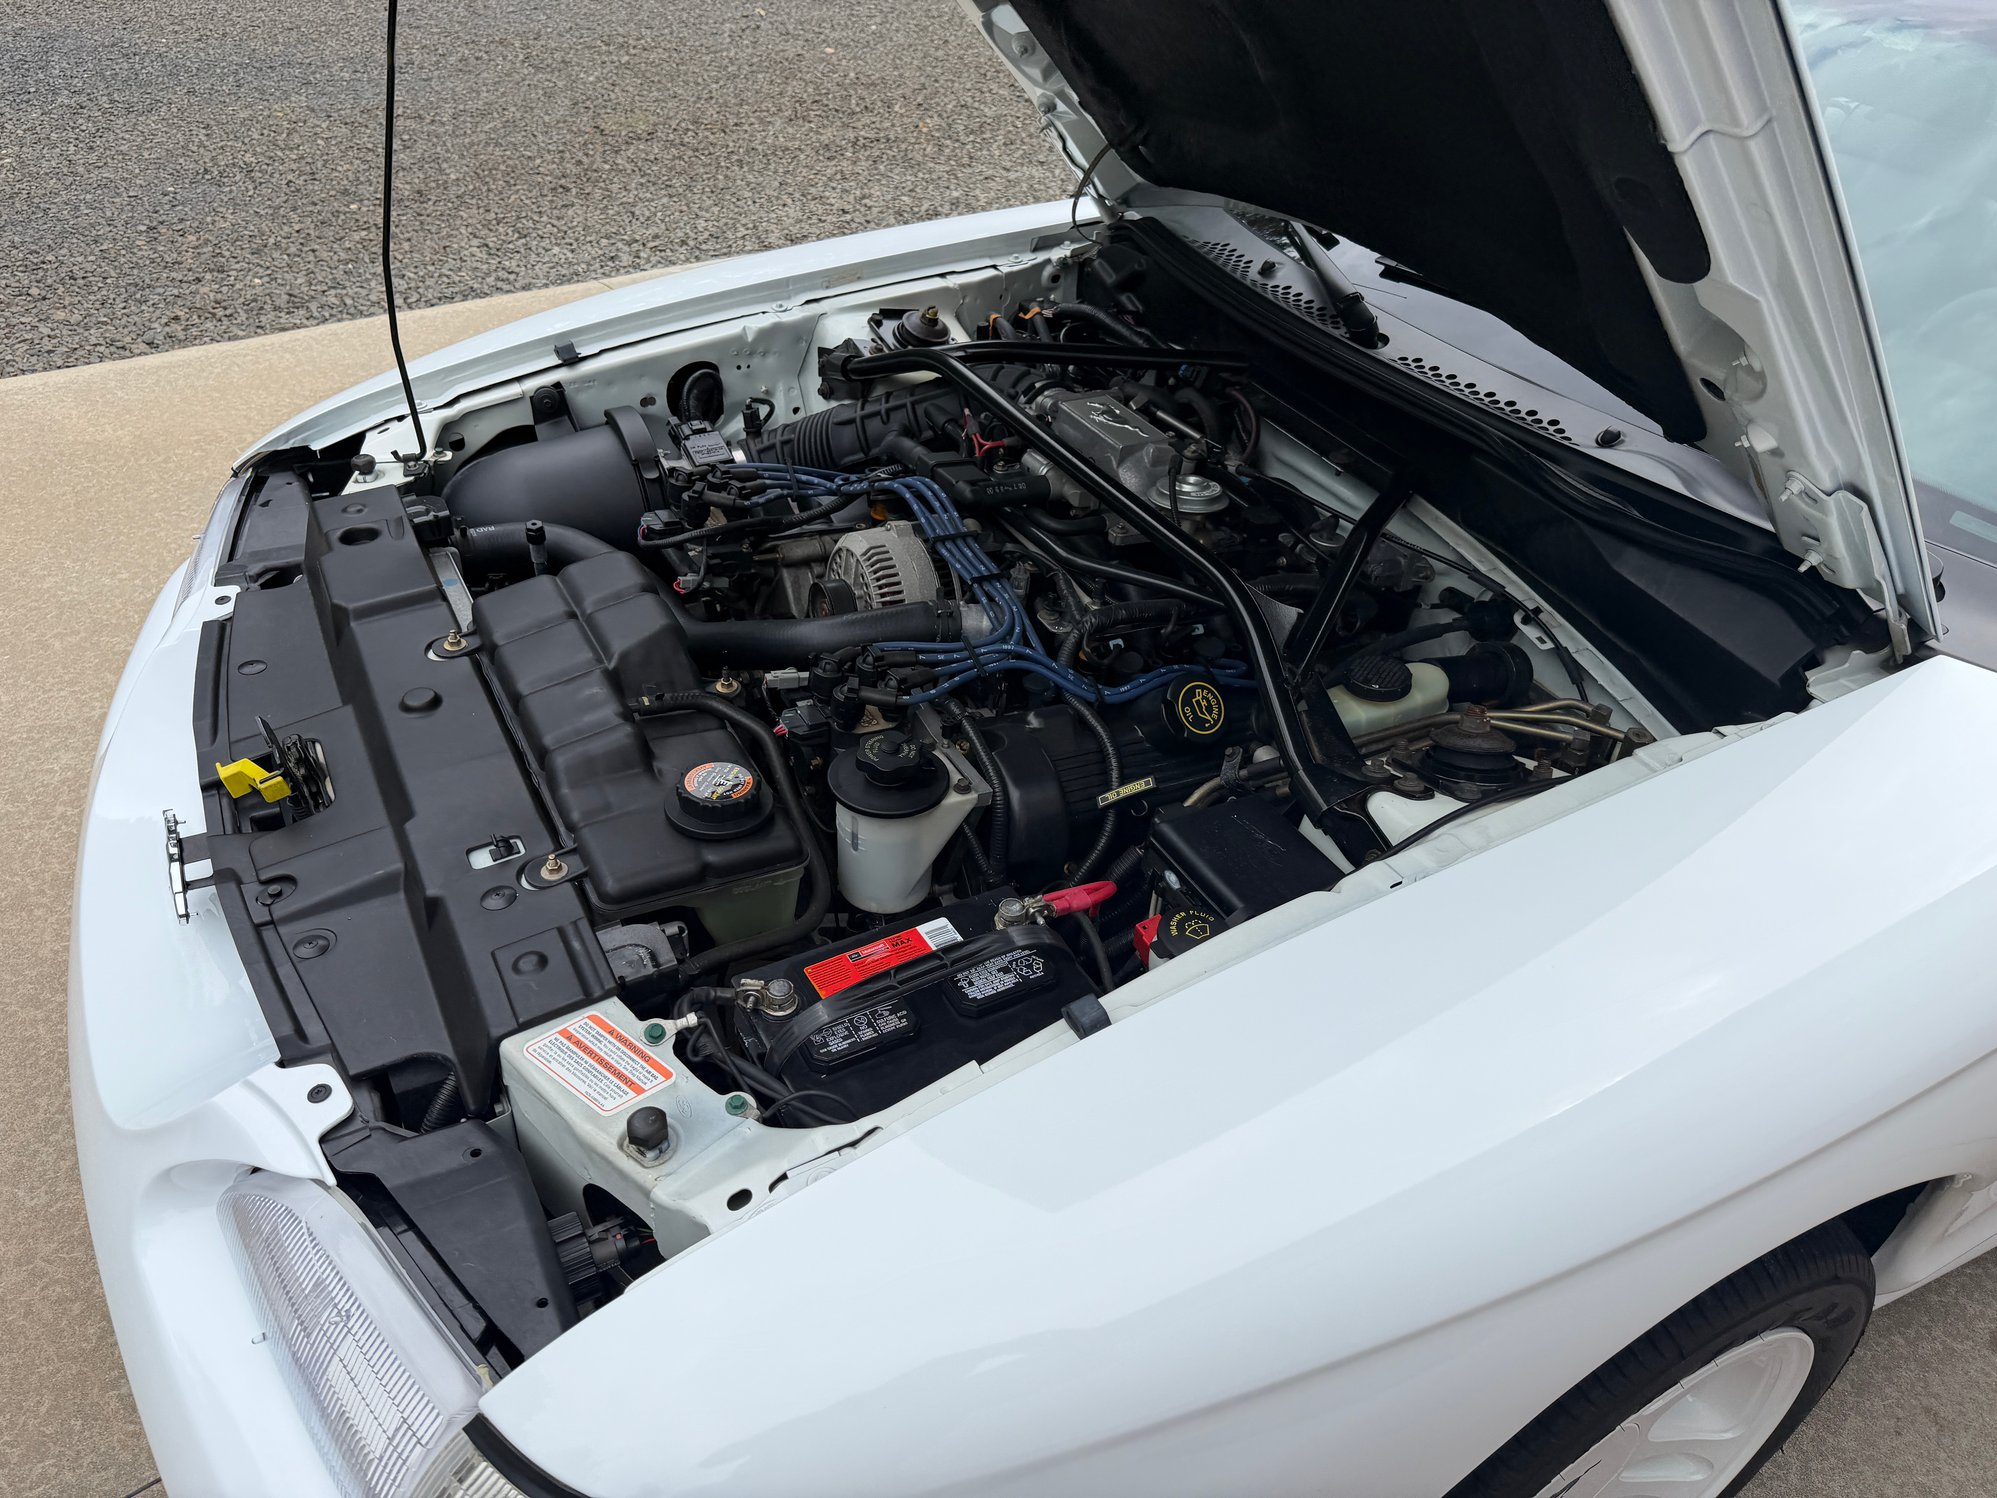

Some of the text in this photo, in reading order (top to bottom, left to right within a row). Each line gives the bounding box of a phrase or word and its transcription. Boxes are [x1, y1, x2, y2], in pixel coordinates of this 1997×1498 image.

[1184, 706, 1194, 722] OIL
[1202, 689, 1219, 720] ENGINE
[1105, 781, 1145, 800] ENGINE OIL
[1169, 910, 1216, 937] WASHER FLUID
[891, 937, 913, 948] MAX
[616, 1033, 651, 1063] WARNING
[573, 1040, 635, 1088] AVERTISSEMENT
